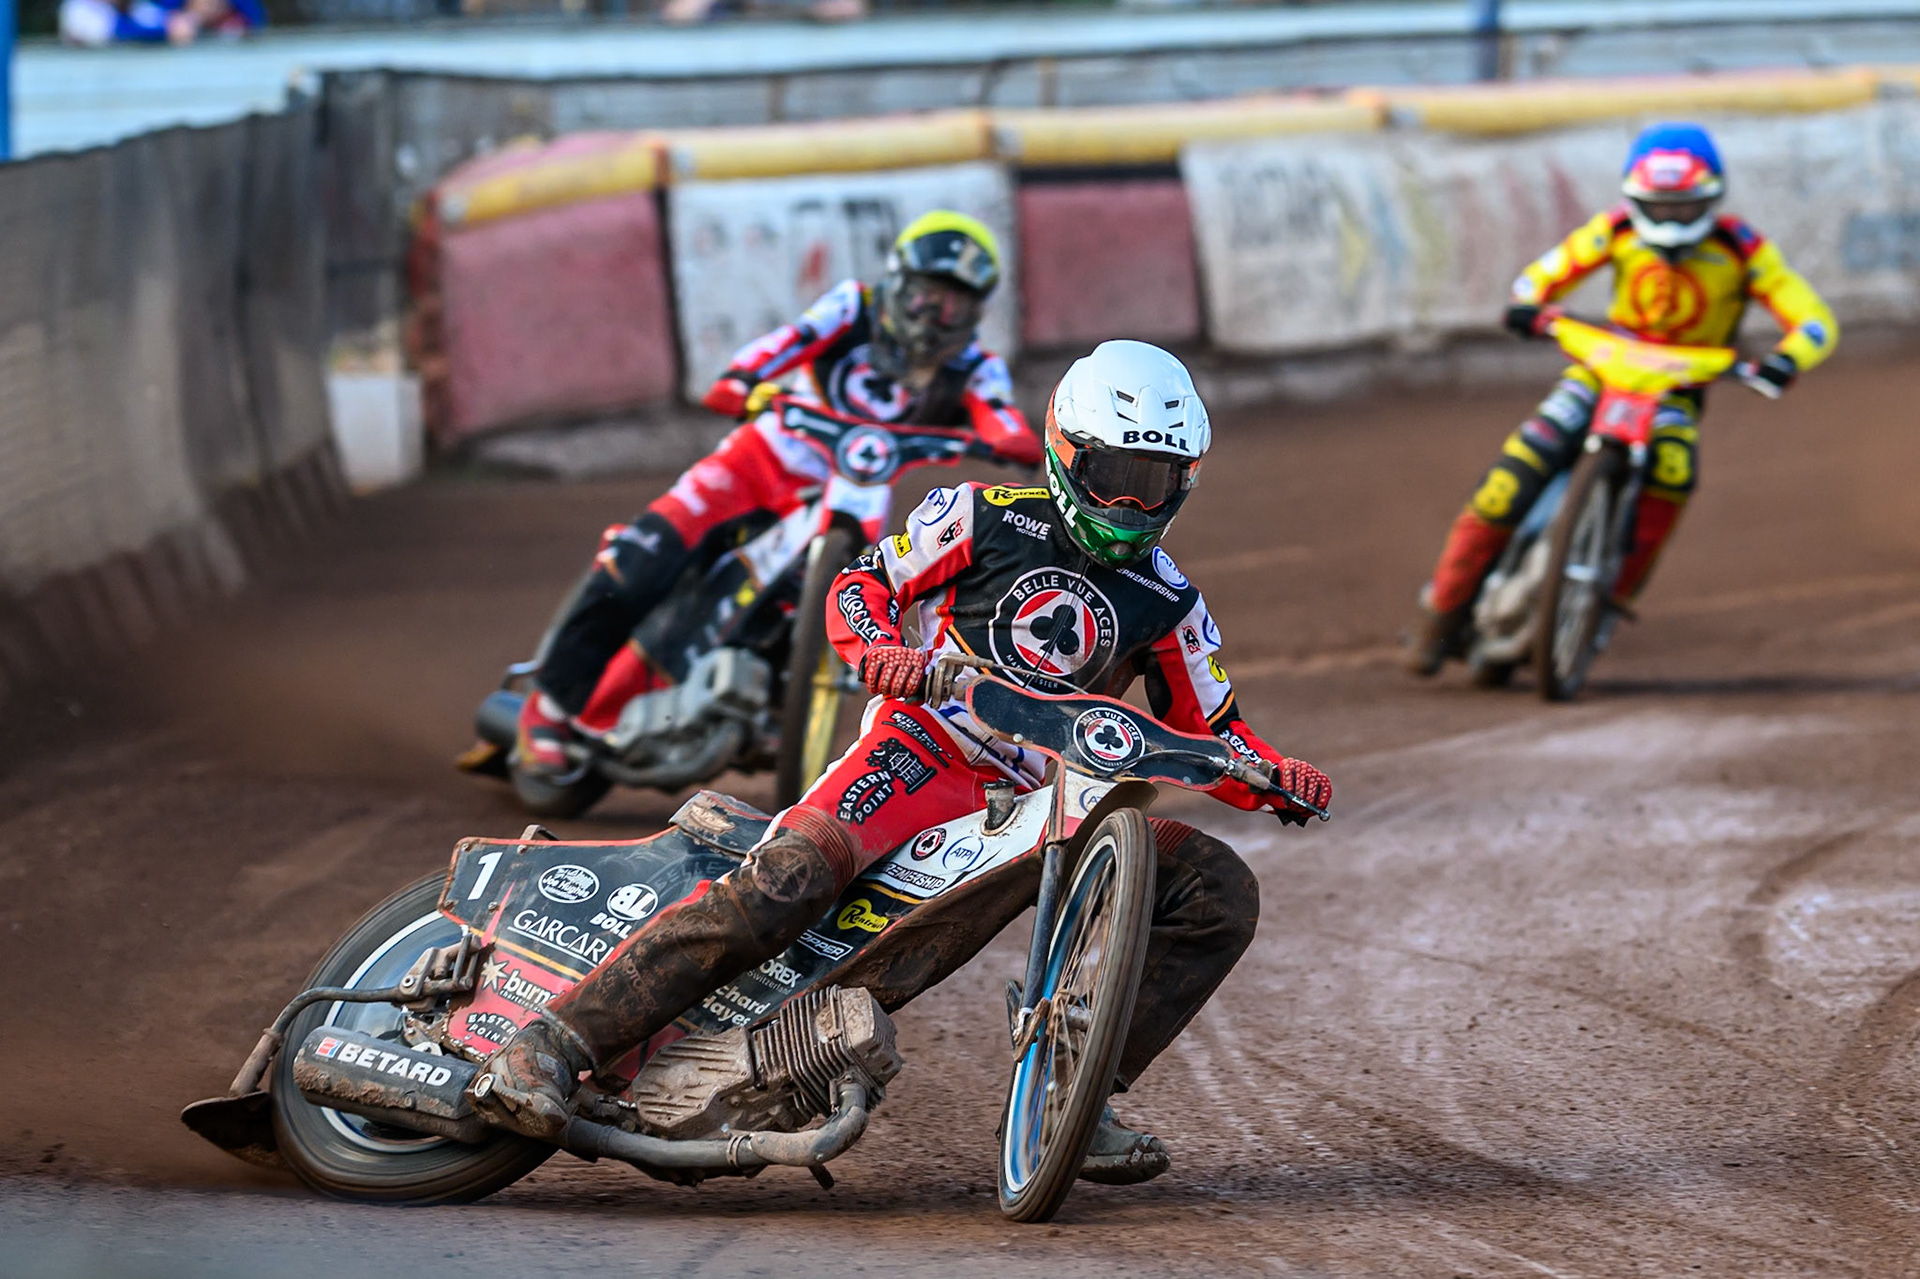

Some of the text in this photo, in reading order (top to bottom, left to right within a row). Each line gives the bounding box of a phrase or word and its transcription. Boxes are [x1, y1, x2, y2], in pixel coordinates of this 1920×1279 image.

[1123, 430, 1190, 452] BOLL
[1002, 509, 1051, 536] ROWE
[1016, 527, 1037, 538] MOTOR
[1012, 574, 1111, 648] BELLE VUE ACES
[1080, 711, 1140, 741] BELLE VUE ACES
[840, 770, 891, 820] EASTERN
[855, 783, 892, 822] POINT
[950, 846, 975, 861] ATPI
[467, 852, 503, 901] 1
[542, 875, 560, 888] Joe
[590, 912, 632, 940] BOLL
[747, 969, 792, 995] Switzerland
[469, 1024, 508, 1044] POINT
[337, 1043, 452, 1086] BETARD
